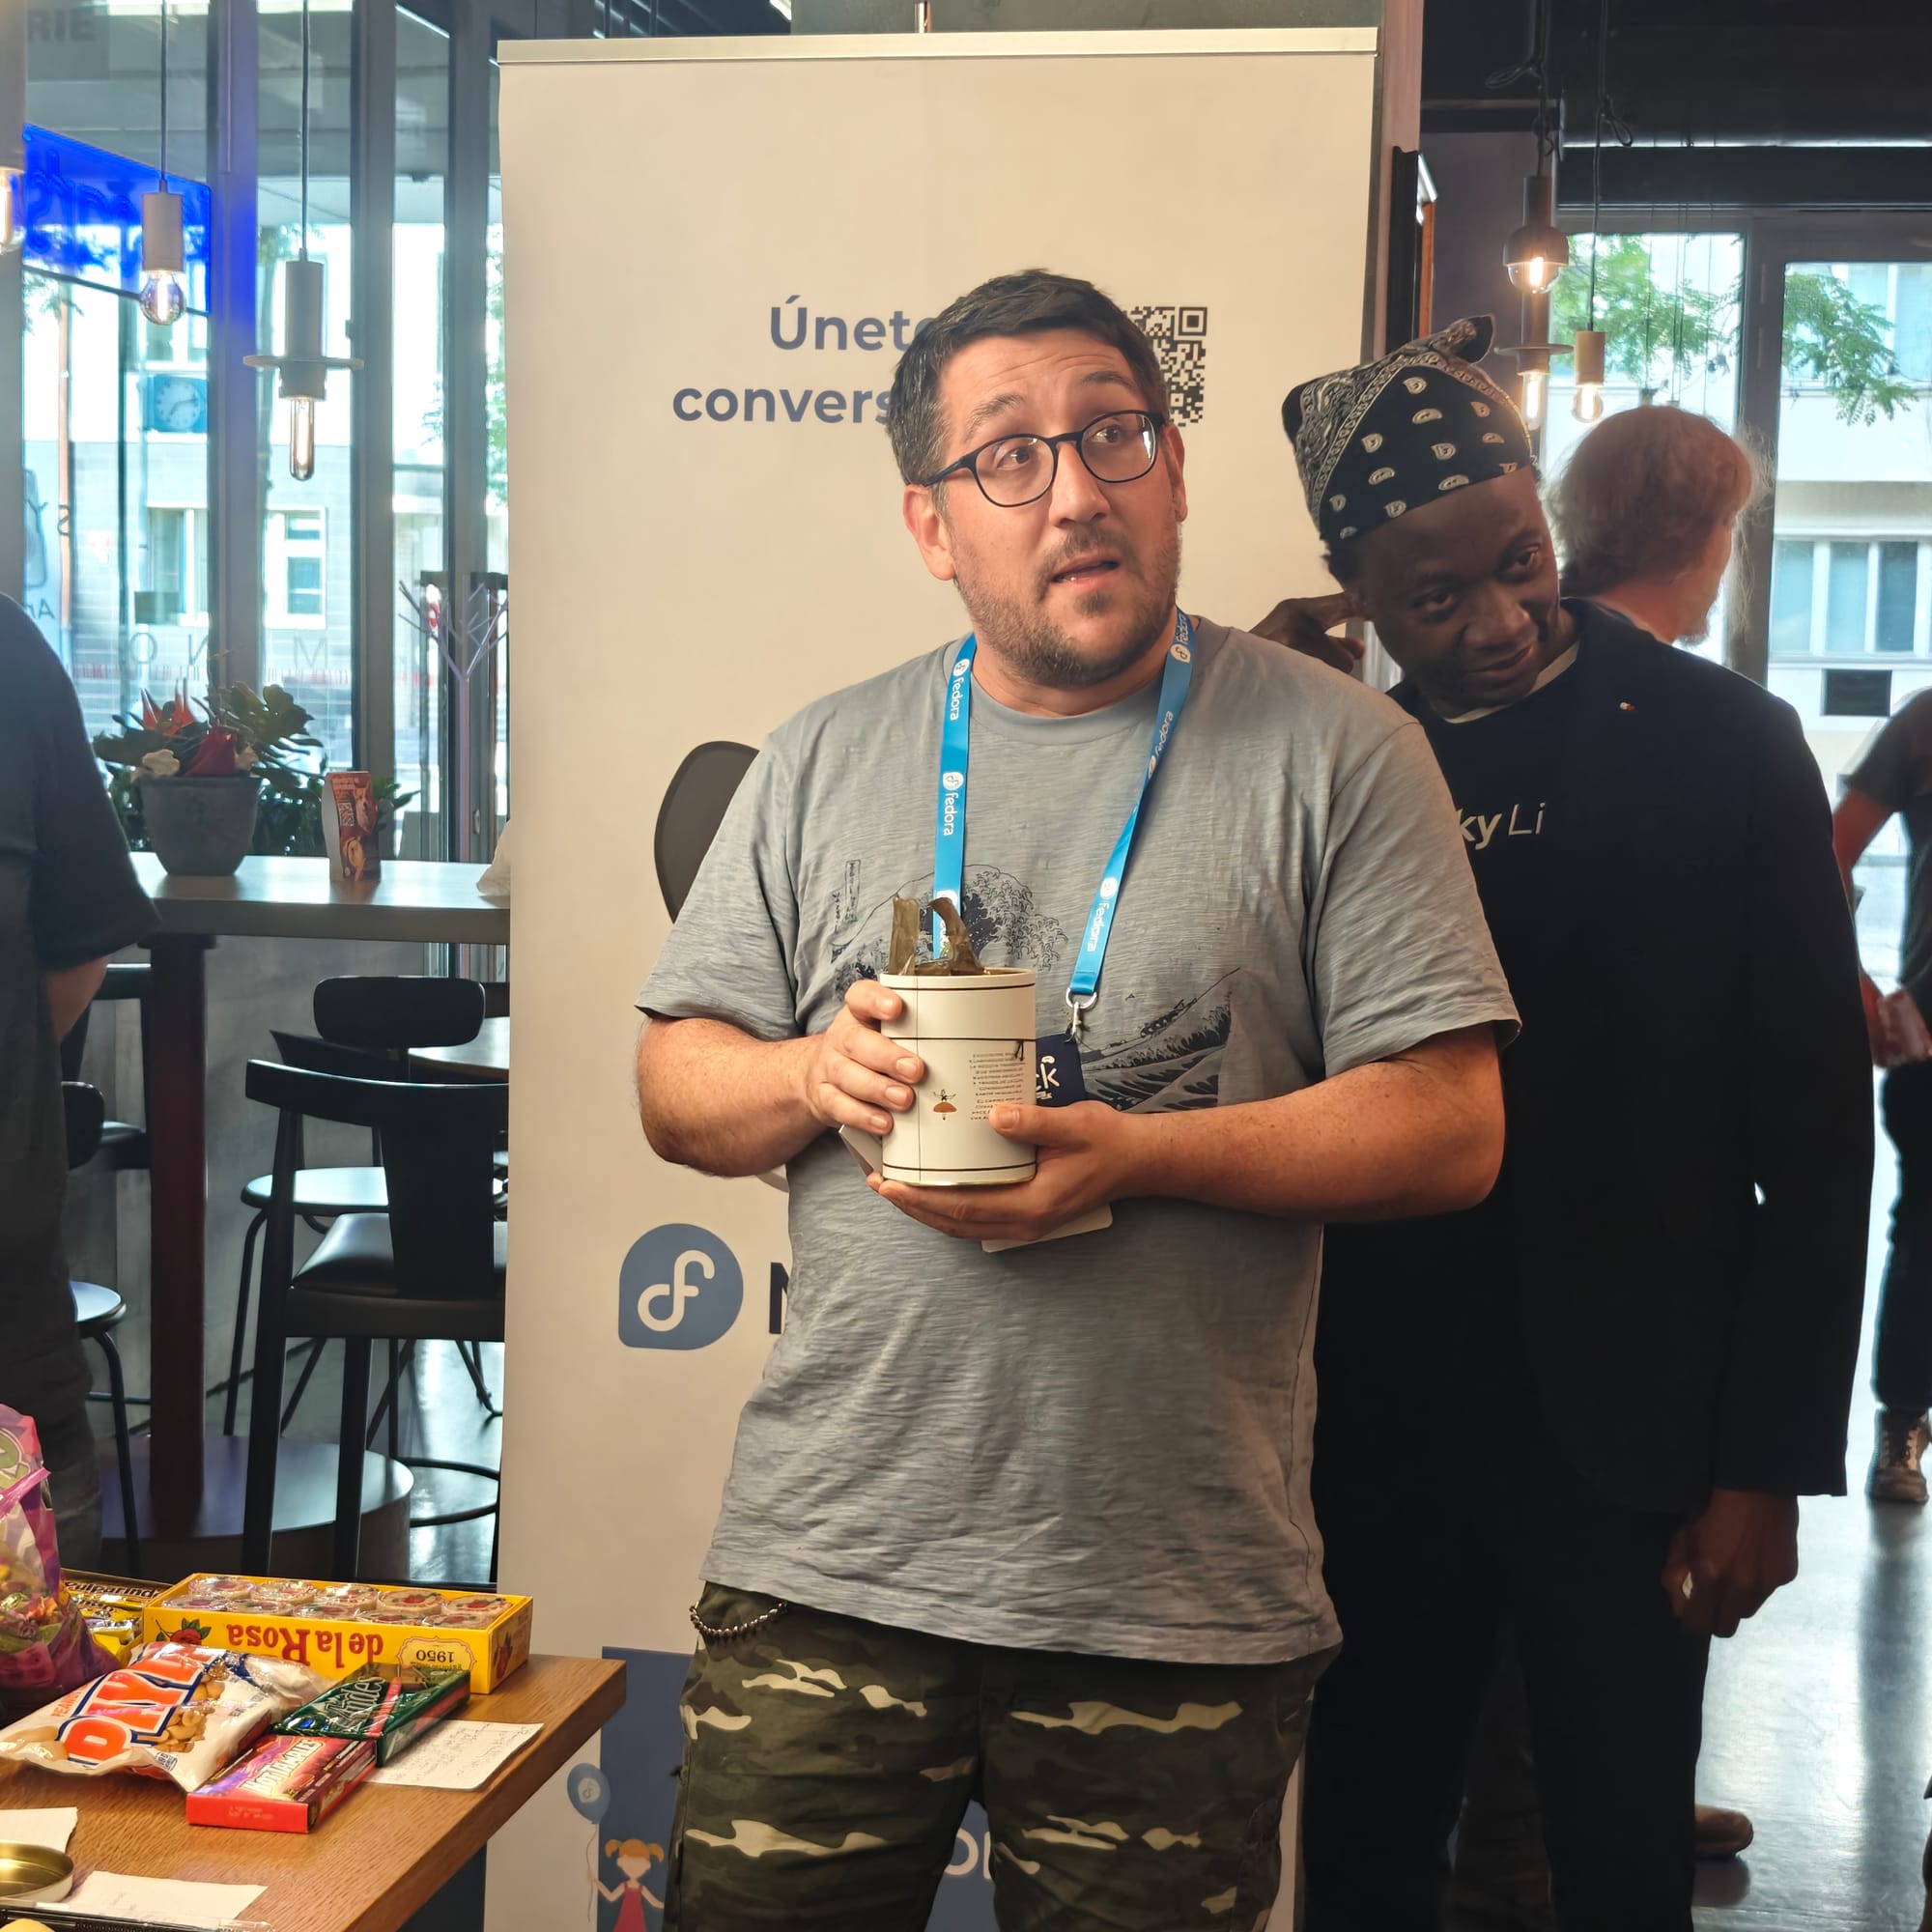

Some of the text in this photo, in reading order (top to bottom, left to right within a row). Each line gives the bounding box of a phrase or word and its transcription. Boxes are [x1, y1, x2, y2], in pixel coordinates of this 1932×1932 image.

[950, 676, 965, 721] fedora
[943, 792, 959, 837] fedora
[1087, 902, 1110, 952] fedora
[225, 1623, 384, 1668] de la Rosa
[415, 1648, 456, 1663] 1950
